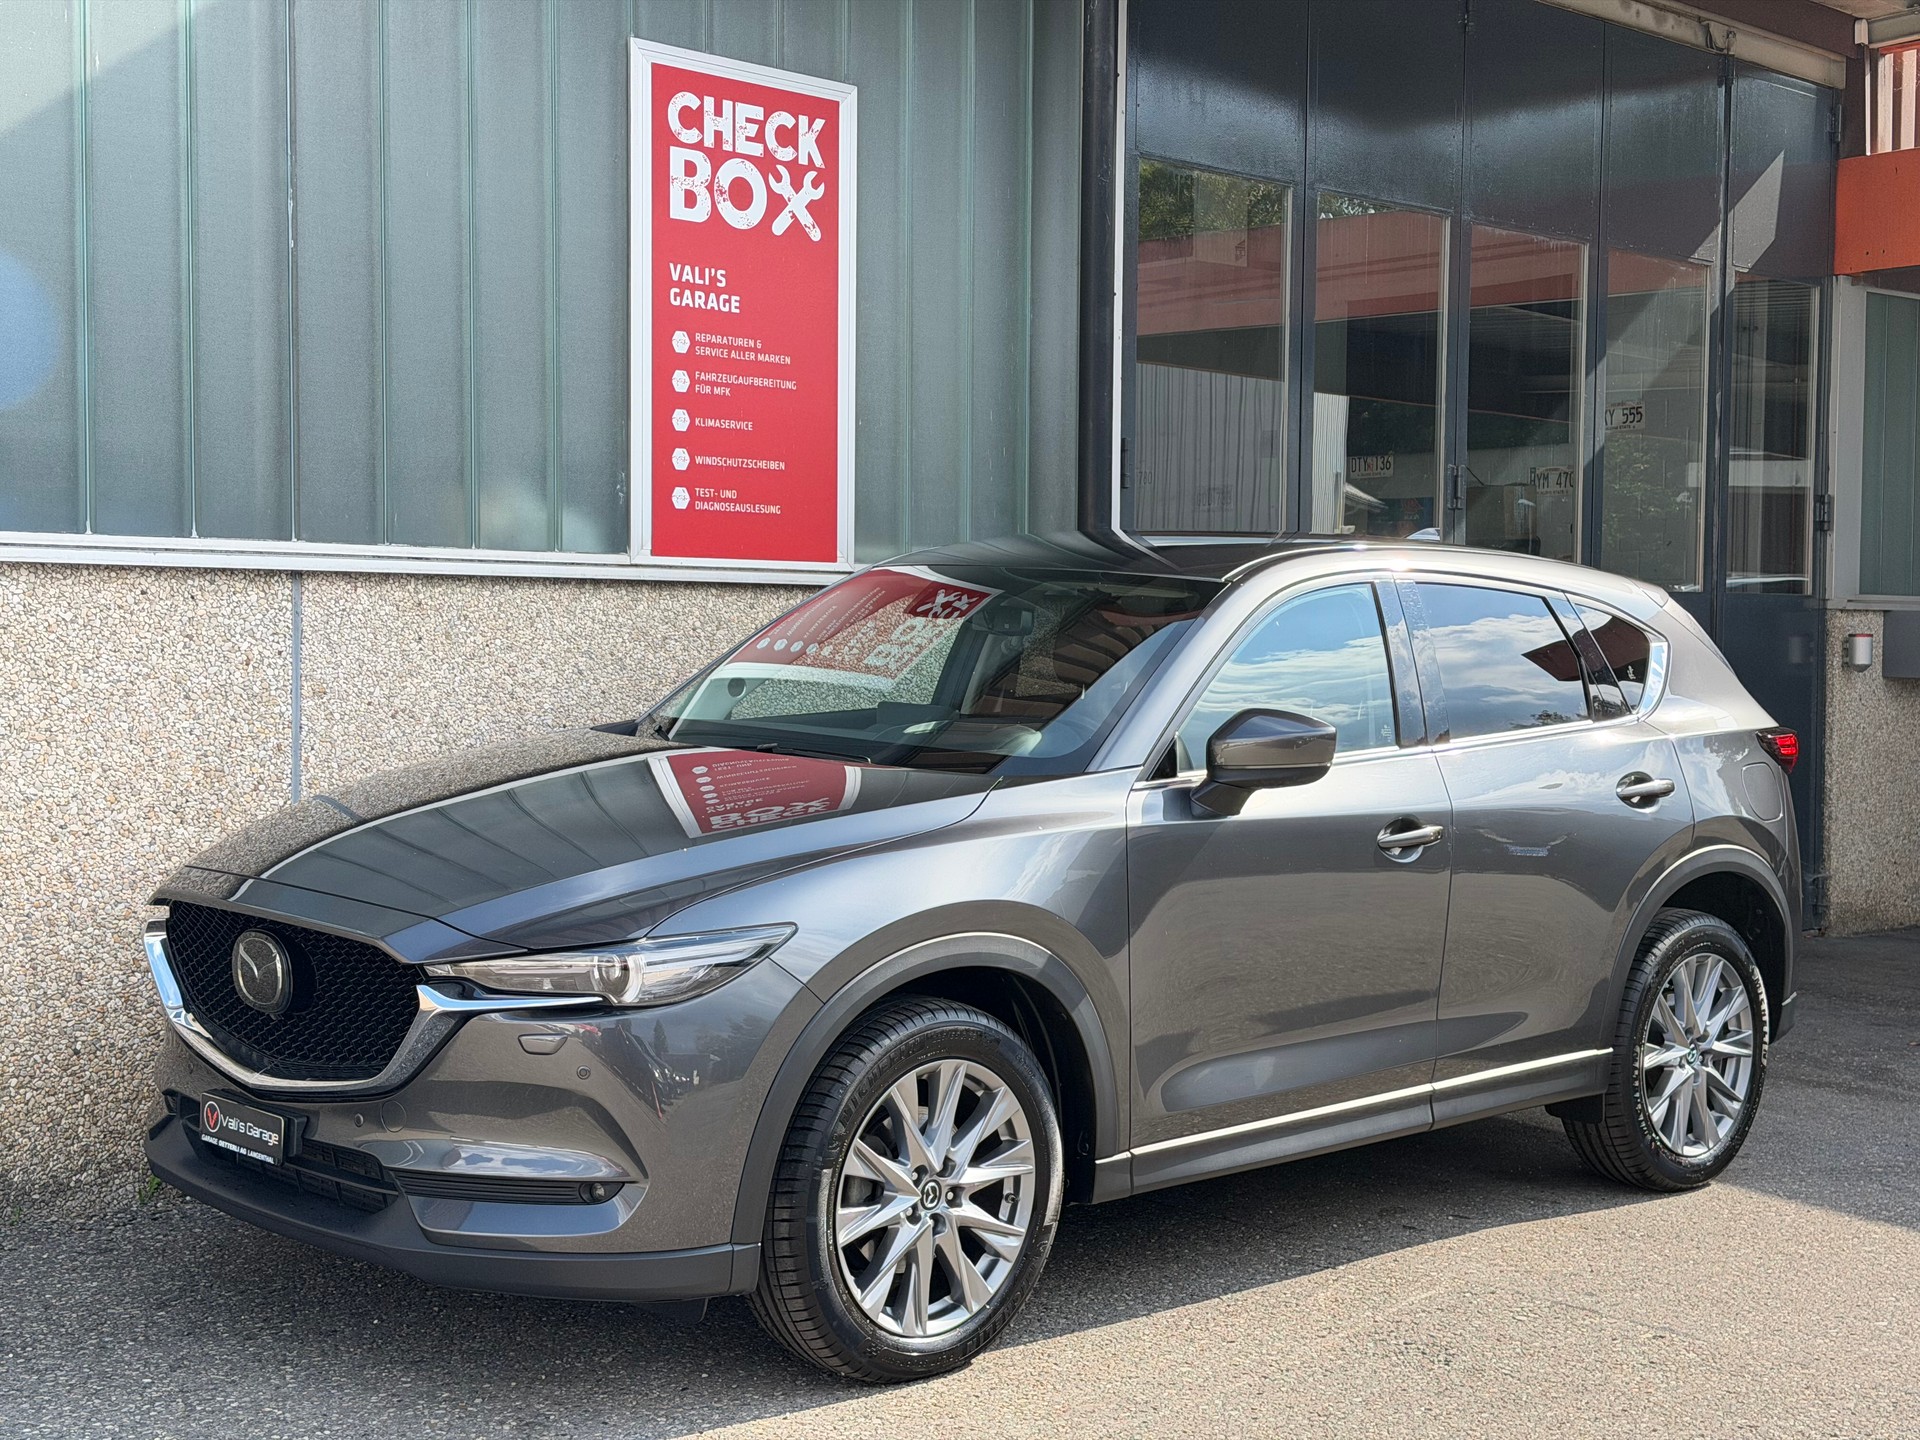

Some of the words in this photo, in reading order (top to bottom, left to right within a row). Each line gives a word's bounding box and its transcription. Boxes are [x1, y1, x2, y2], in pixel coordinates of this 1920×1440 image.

[667, 91, 826, 169] CHECK
[669, 145, 825, 242] BOX
[669, 262, 726, 288] VALI'S
[669, 287, 741, 314] GARAGE
[695, 332, 754, 348] REPARATUREN
[756, 339, 762, 349] &
[695, 345, 729, 358] SERVICE
[730, 350, 756, 361] ALLER
[757, 353, 791, 365] MARKEN
[695, 371, 797, 390] FAHRZEUGAUFBEREITUNG
[695, 384, 712, 395] FÜR
[713, 386, 731, 397] MFK
[695, 417, 753, 431] KLIMASERVICE
[1621, 406, 1643, 424] 555
[694, 455, 785, 471] WINDSCHUTZSCHEIBEN
[1351, 456, 1368, 473] DTY
[1375, 455, 1392, 471] 136
[694, 487, 718, 498] TEST-
[719, 489, 738, 499] UND
[694, 500, 781, 515] DIAGNOSEAUSLESUNG
[220, 1114, 246, 1133] Vali's
[246, 1122, 279, 1146] Garage
